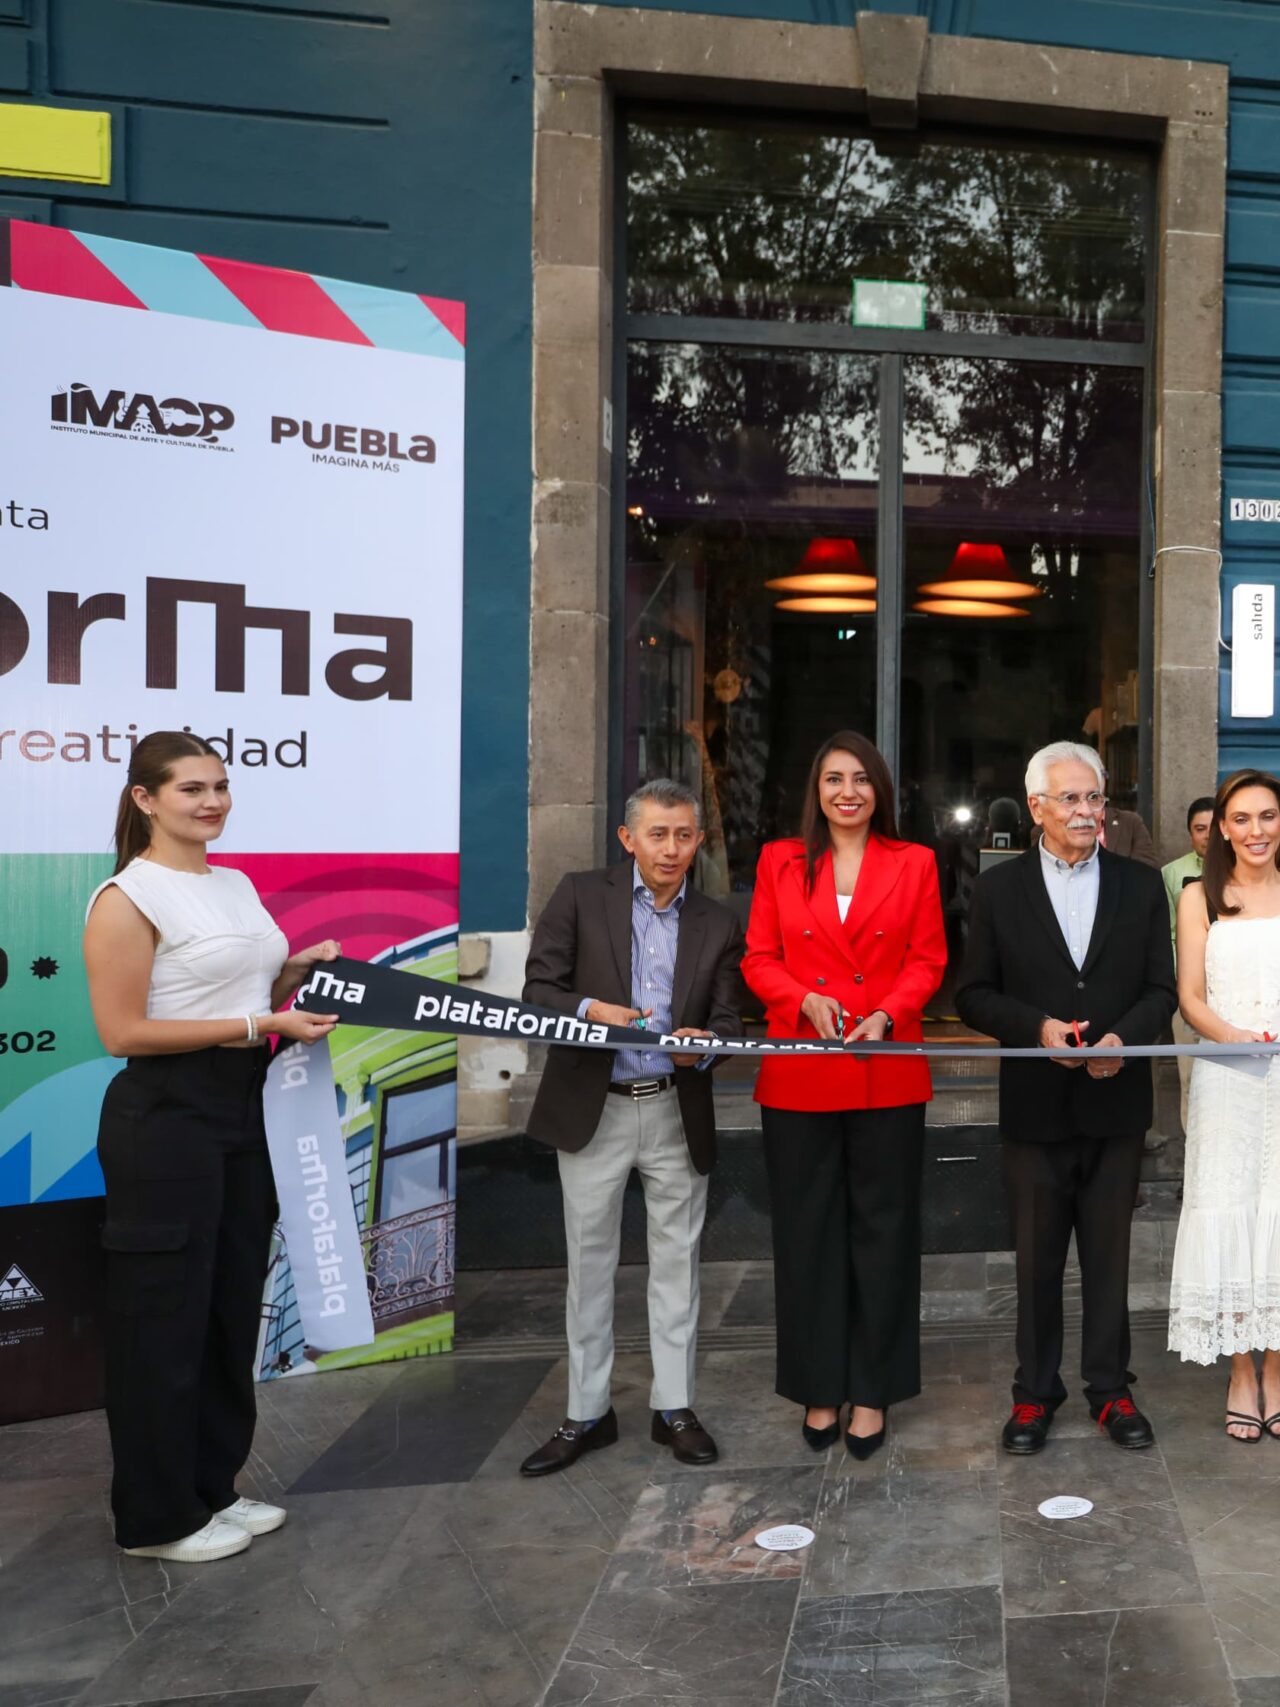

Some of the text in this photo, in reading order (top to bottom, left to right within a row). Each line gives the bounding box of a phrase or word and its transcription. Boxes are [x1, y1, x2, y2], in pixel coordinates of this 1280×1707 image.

[51, 425, 88, 434] INSTITUTO
[89, 430, 128, 439] MUNICIPAL
[165, 440, 197, 448] CULTURA
[209, 445, 235, 453] PUEBLA
[312, 453, 400, 473] IMAGINA MÁS
[0, 500, 48, 530] ta
[1251, 593, 1263, 640] salida
[0, 723, 307, 768] reatidad
[414, 995, 609, 1044] plataforma
